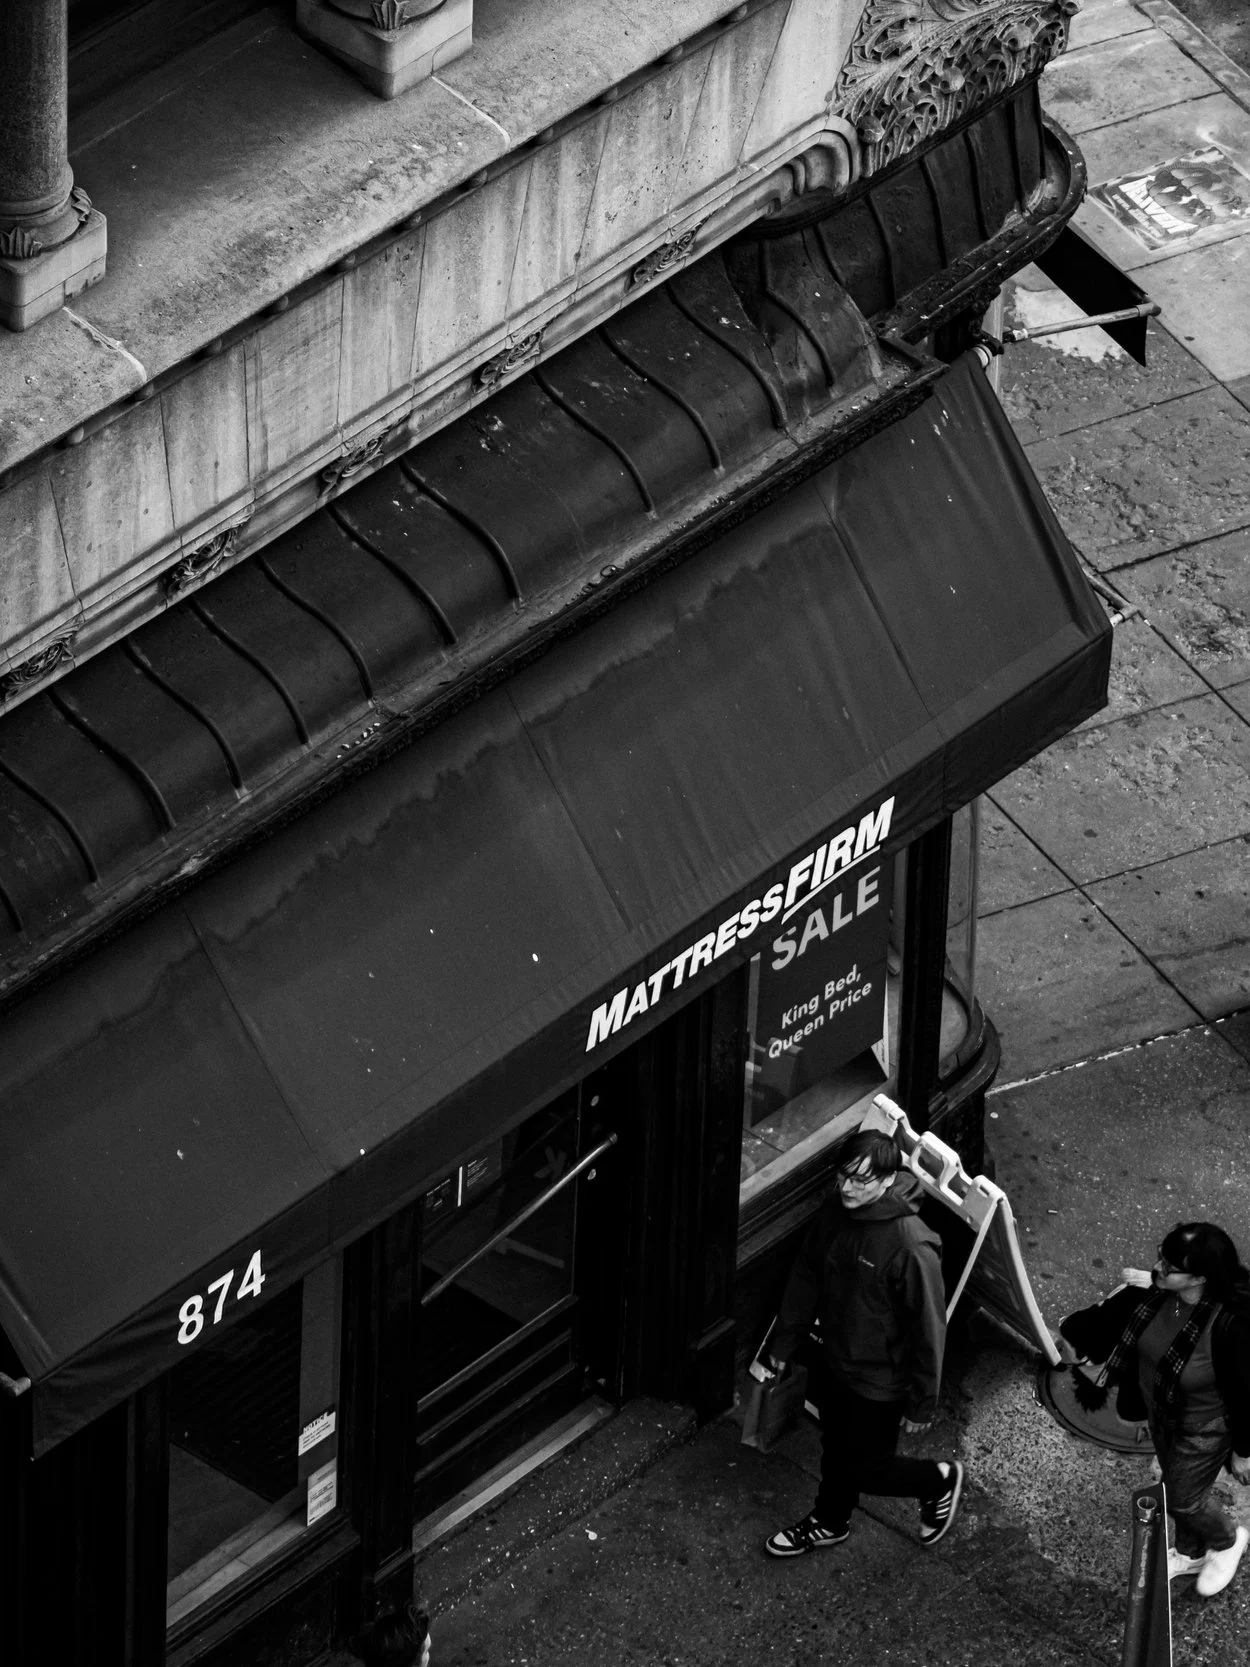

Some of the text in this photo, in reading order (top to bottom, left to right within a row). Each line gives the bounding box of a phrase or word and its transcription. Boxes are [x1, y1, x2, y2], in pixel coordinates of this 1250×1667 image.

[771, 866, 881, 971] SALE
[768, 981, 873, 1060] Queen Price
[781, 963, 862, 1030] King Bed,
[177, 1249, 266, 1345] 874
